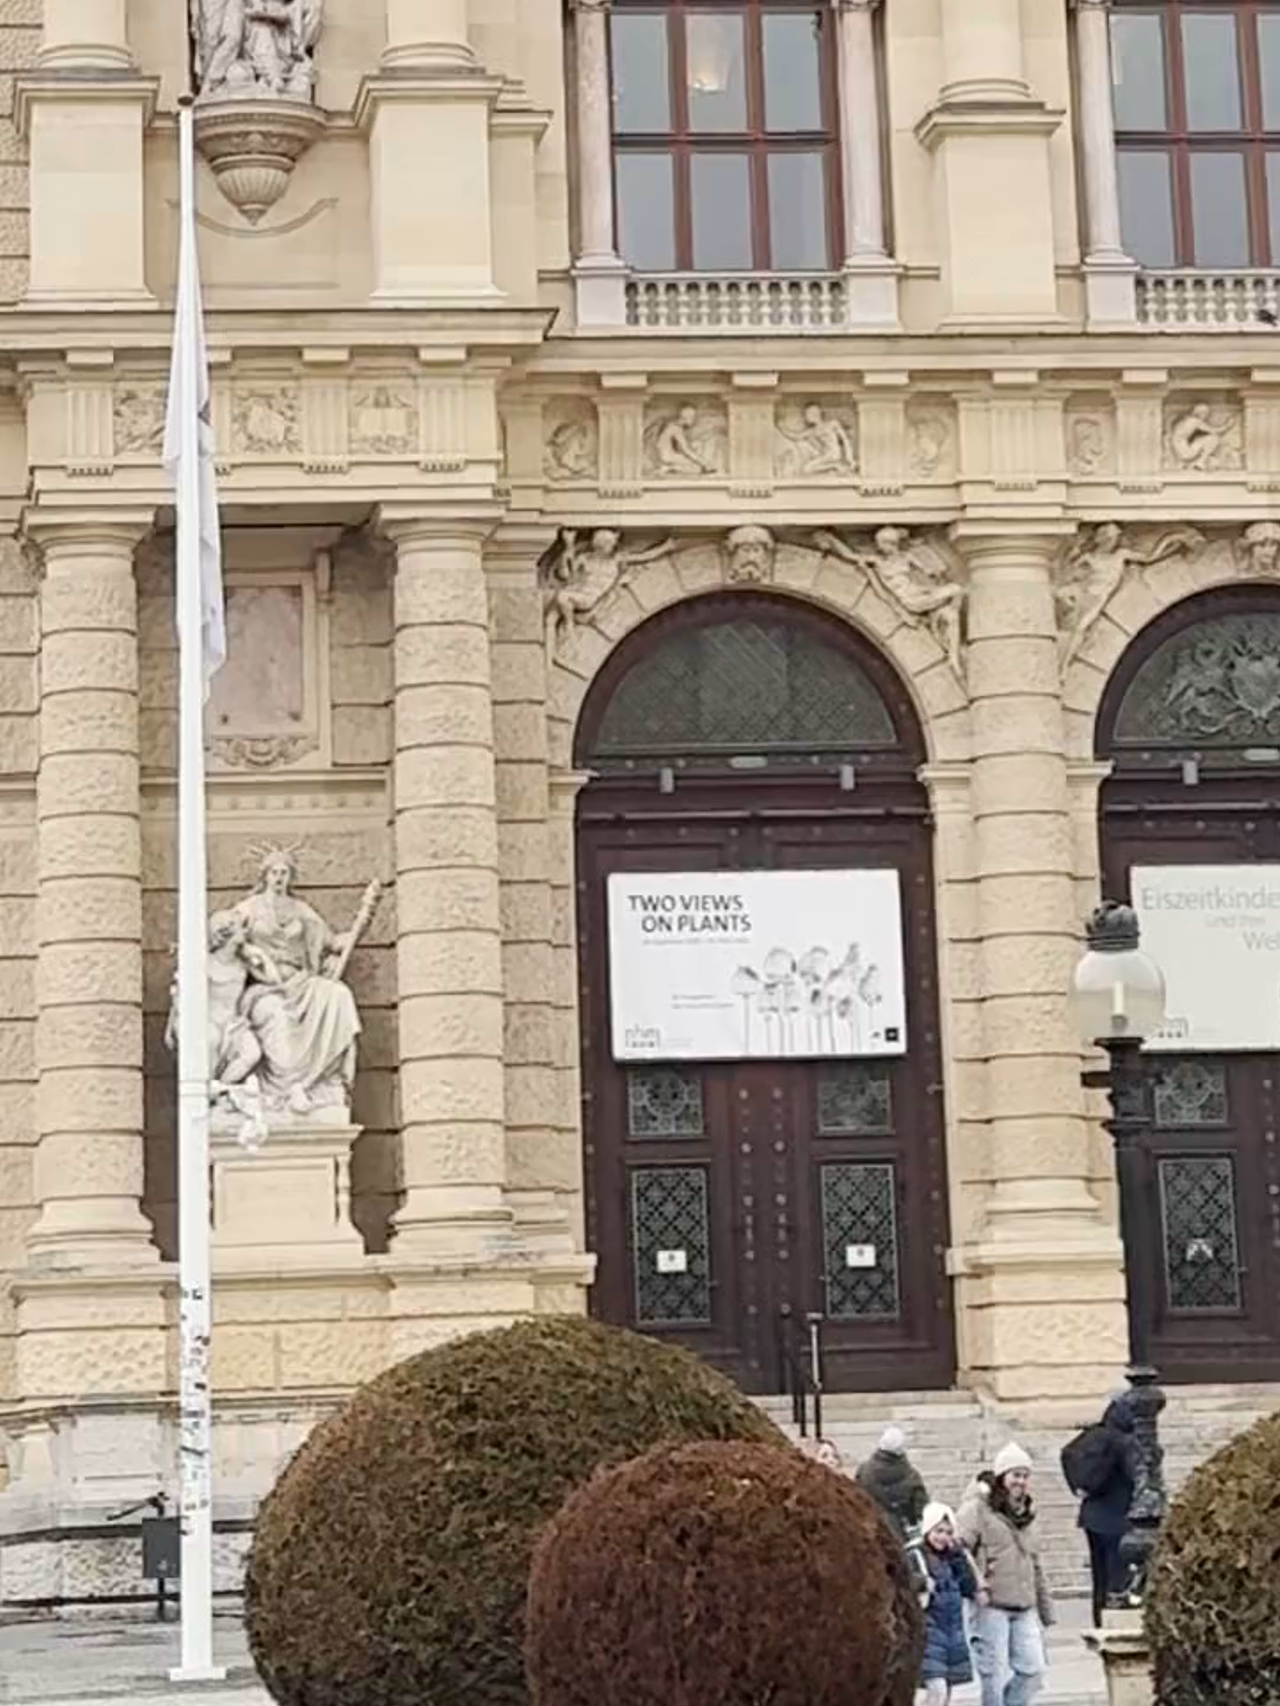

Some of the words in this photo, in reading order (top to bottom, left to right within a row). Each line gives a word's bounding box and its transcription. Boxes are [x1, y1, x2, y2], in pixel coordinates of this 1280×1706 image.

[628, 894, 676, 912] TWO
[681, 894, 744, 912] VIEWS
[641, 914, 673, 934] ON
[677, 914, 752, 933] PLANTS
